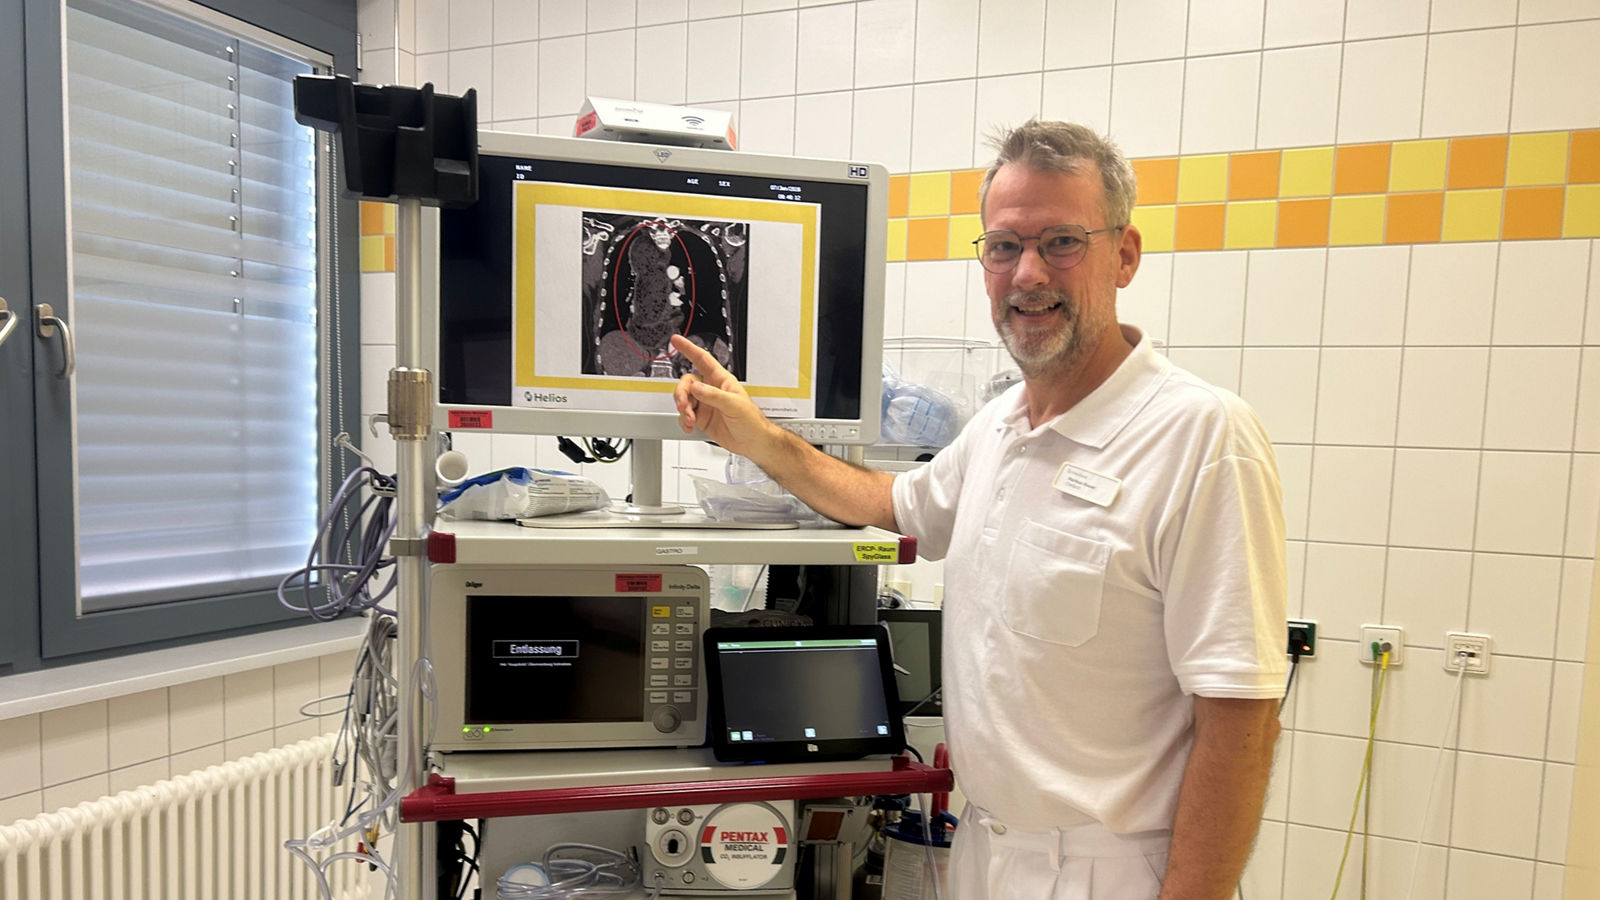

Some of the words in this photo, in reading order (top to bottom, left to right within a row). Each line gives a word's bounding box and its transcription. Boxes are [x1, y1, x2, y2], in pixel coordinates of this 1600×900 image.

[850, 167, 867, 176] HD
[534, 392, 568, 402] Helios
[510, 644, 562, 655] Entlassung
[721, 831, 768, 842] PENTAX
[724, 844, 764, 852] MEDICAL
